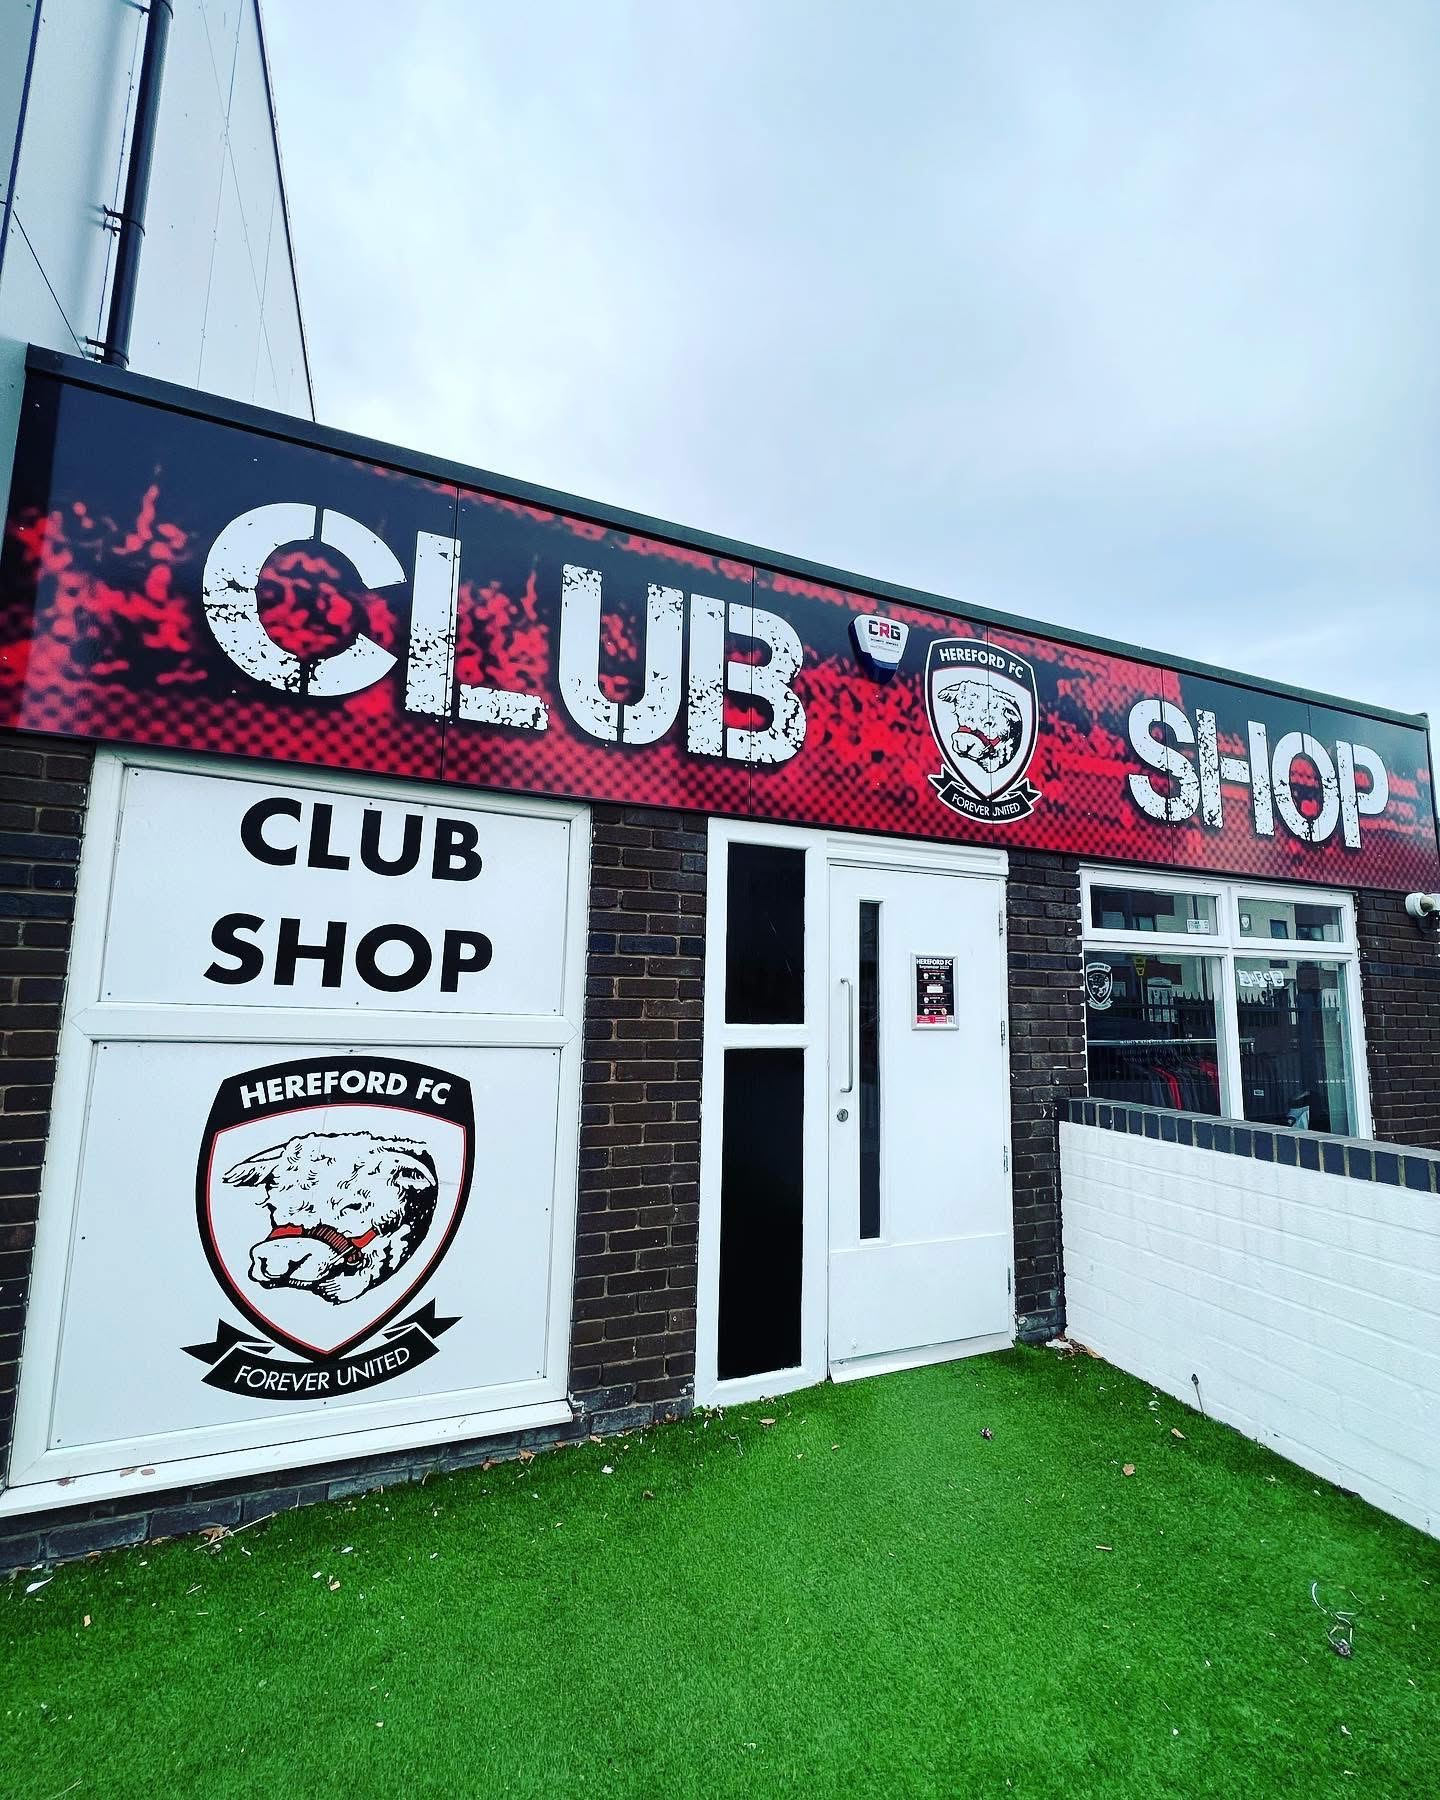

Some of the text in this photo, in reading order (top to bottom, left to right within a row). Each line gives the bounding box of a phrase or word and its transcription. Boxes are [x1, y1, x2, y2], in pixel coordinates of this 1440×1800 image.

[869, 620, 901, 640] CRG
[203, 502, 1389, 849] CLUB SHOP
[939, 648, 1024, 679] HEREFORD FC
[951, 793, 990, 817] FOREVER
[240, 797, 483, 882] CLUB
[203, 913, 493, 993] SHOP
[240, 1070, 451, 1109] HEREFORD FC
[234, 1347, 410, 1392] FOREVER UNITED
